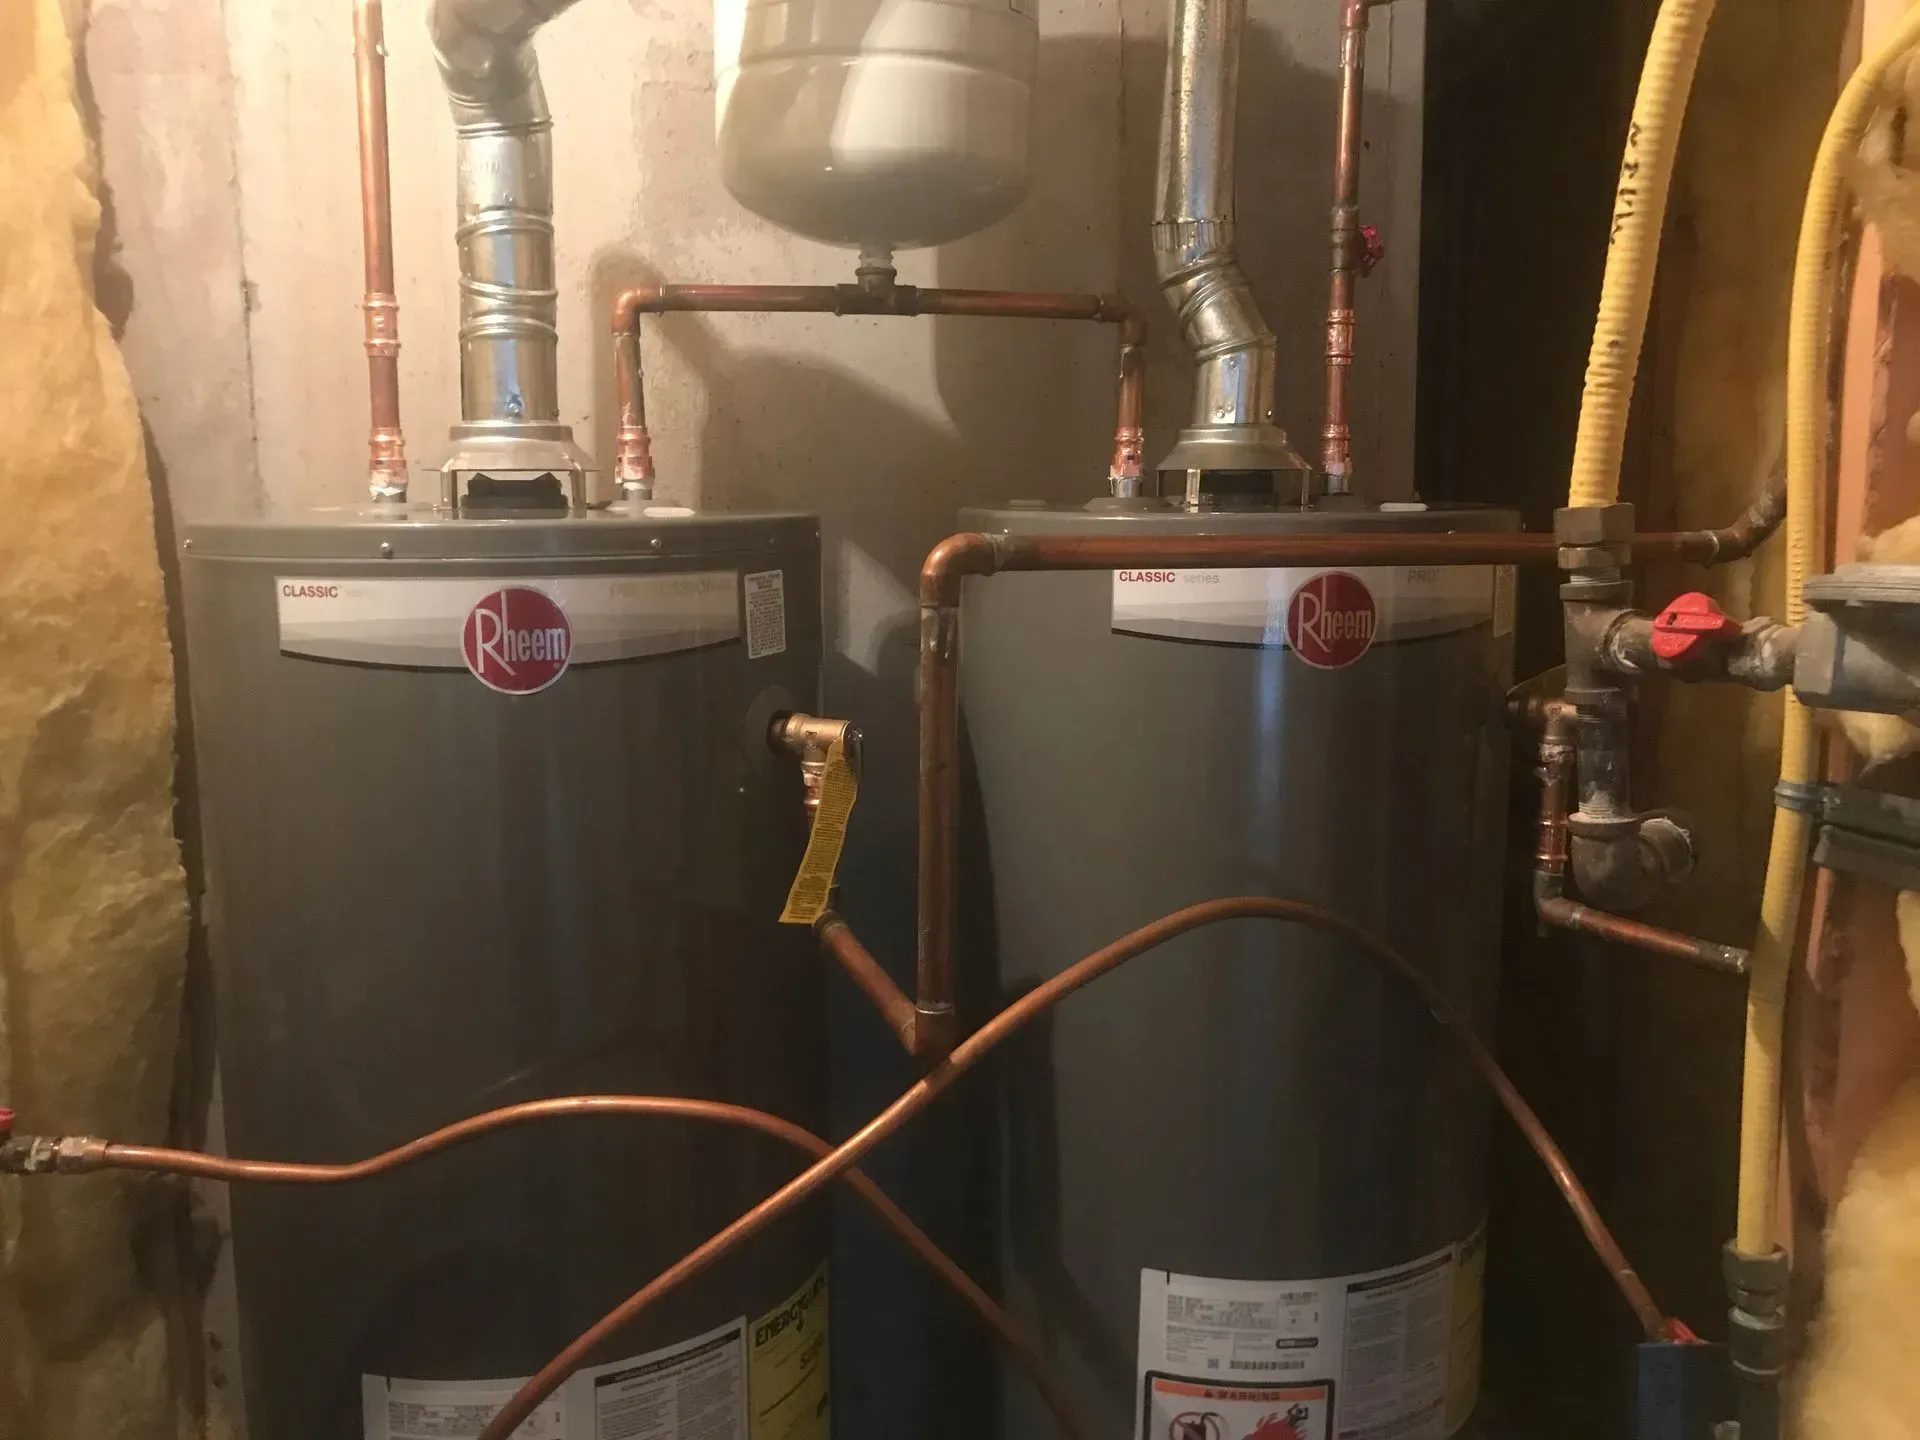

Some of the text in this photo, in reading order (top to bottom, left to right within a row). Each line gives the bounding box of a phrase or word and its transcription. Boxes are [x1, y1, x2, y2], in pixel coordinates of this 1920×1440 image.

[1119, 571, 1176, 583] CLASSIC
[283, 585, 339, 598] CLASSIC
[1297, 577, 1374, 653] Rheem
[474, 590, 567, 676] Rheem
[1217, 1390, 1280, 1401] WARNING
